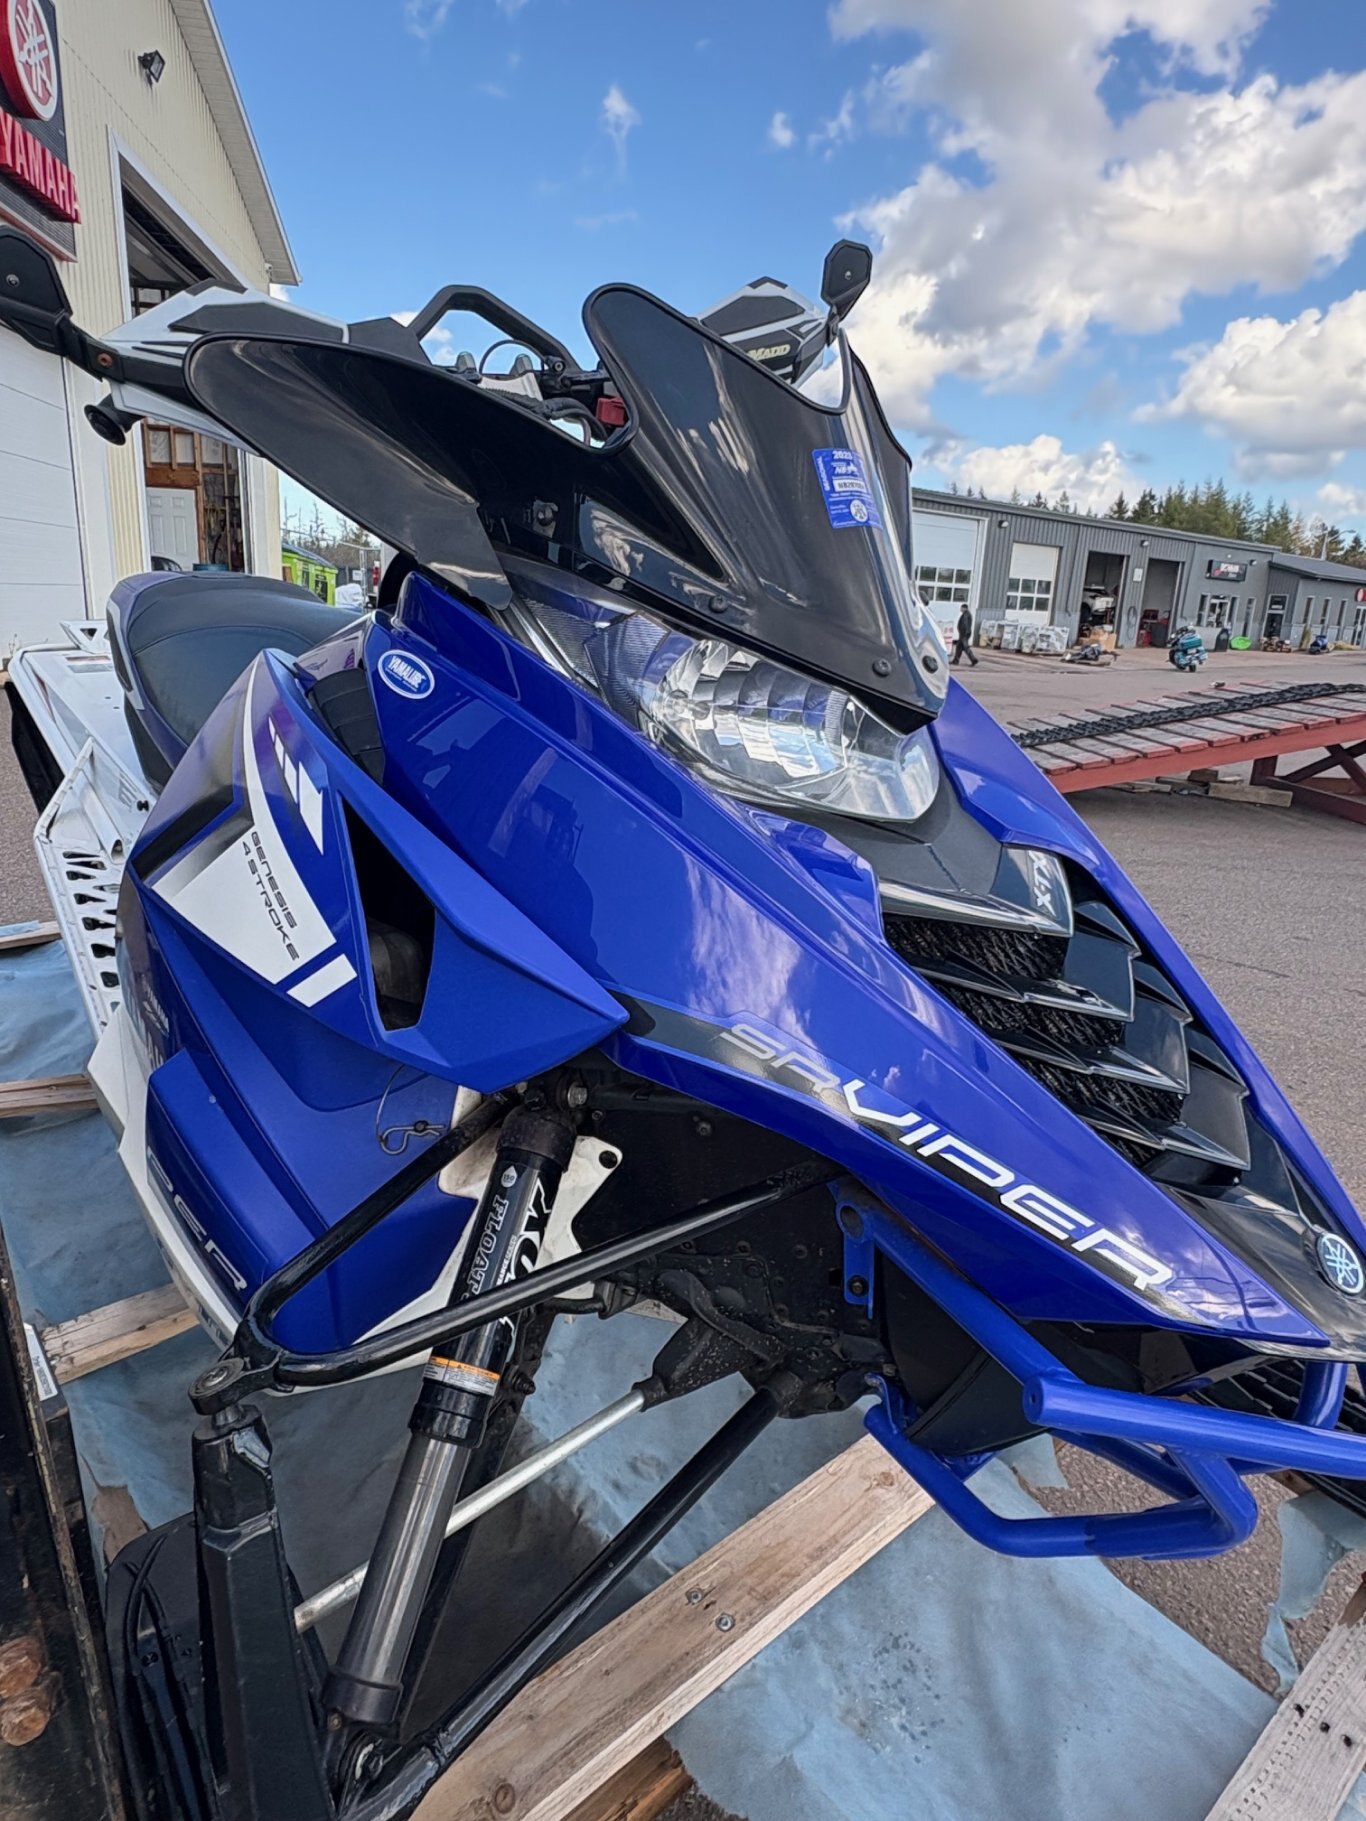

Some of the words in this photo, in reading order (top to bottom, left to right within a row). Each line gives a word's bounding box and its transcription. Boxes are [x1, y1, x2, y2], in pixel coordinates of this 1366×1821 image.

[0, 105, 81, 224] YAMAHA
[242, 841, 251, 856] 4
[247, 858, 300, 961] STROKE
[251, 831, 297, 929] GENESIS
[466, 1194, 509, 1295] FLOAT
